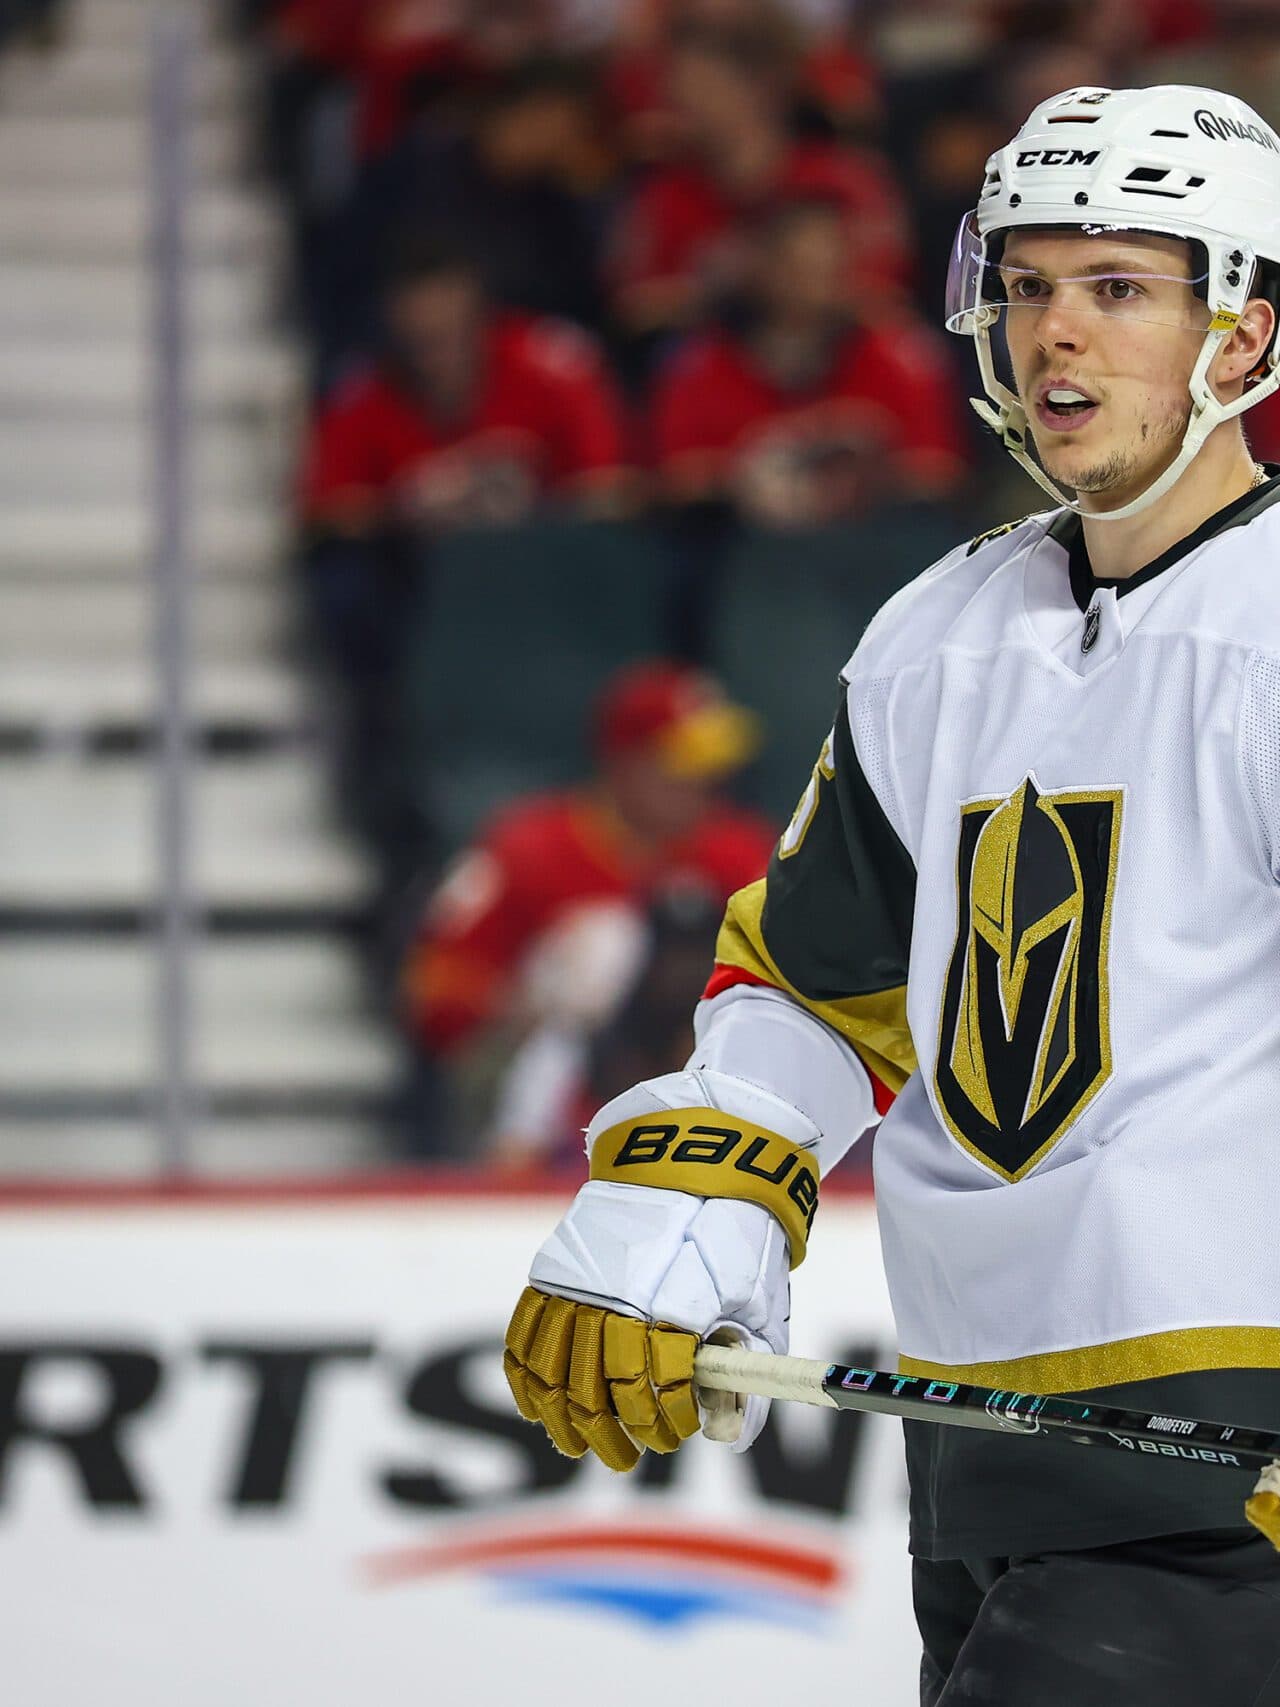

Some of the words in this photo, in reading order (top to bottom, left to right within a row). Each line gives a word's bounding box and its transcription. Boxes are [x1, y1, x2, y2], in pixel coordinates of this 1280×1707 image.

[1016, 150, 1100, 168] CCM
[1217, 314, 1238, 324] CCM
[612, 1124, 818, 1241] BAUE
[1146, 1415, 1197, 1435] DOROFEYEV
[1138, 1440, 1241, 1466] BAUER
